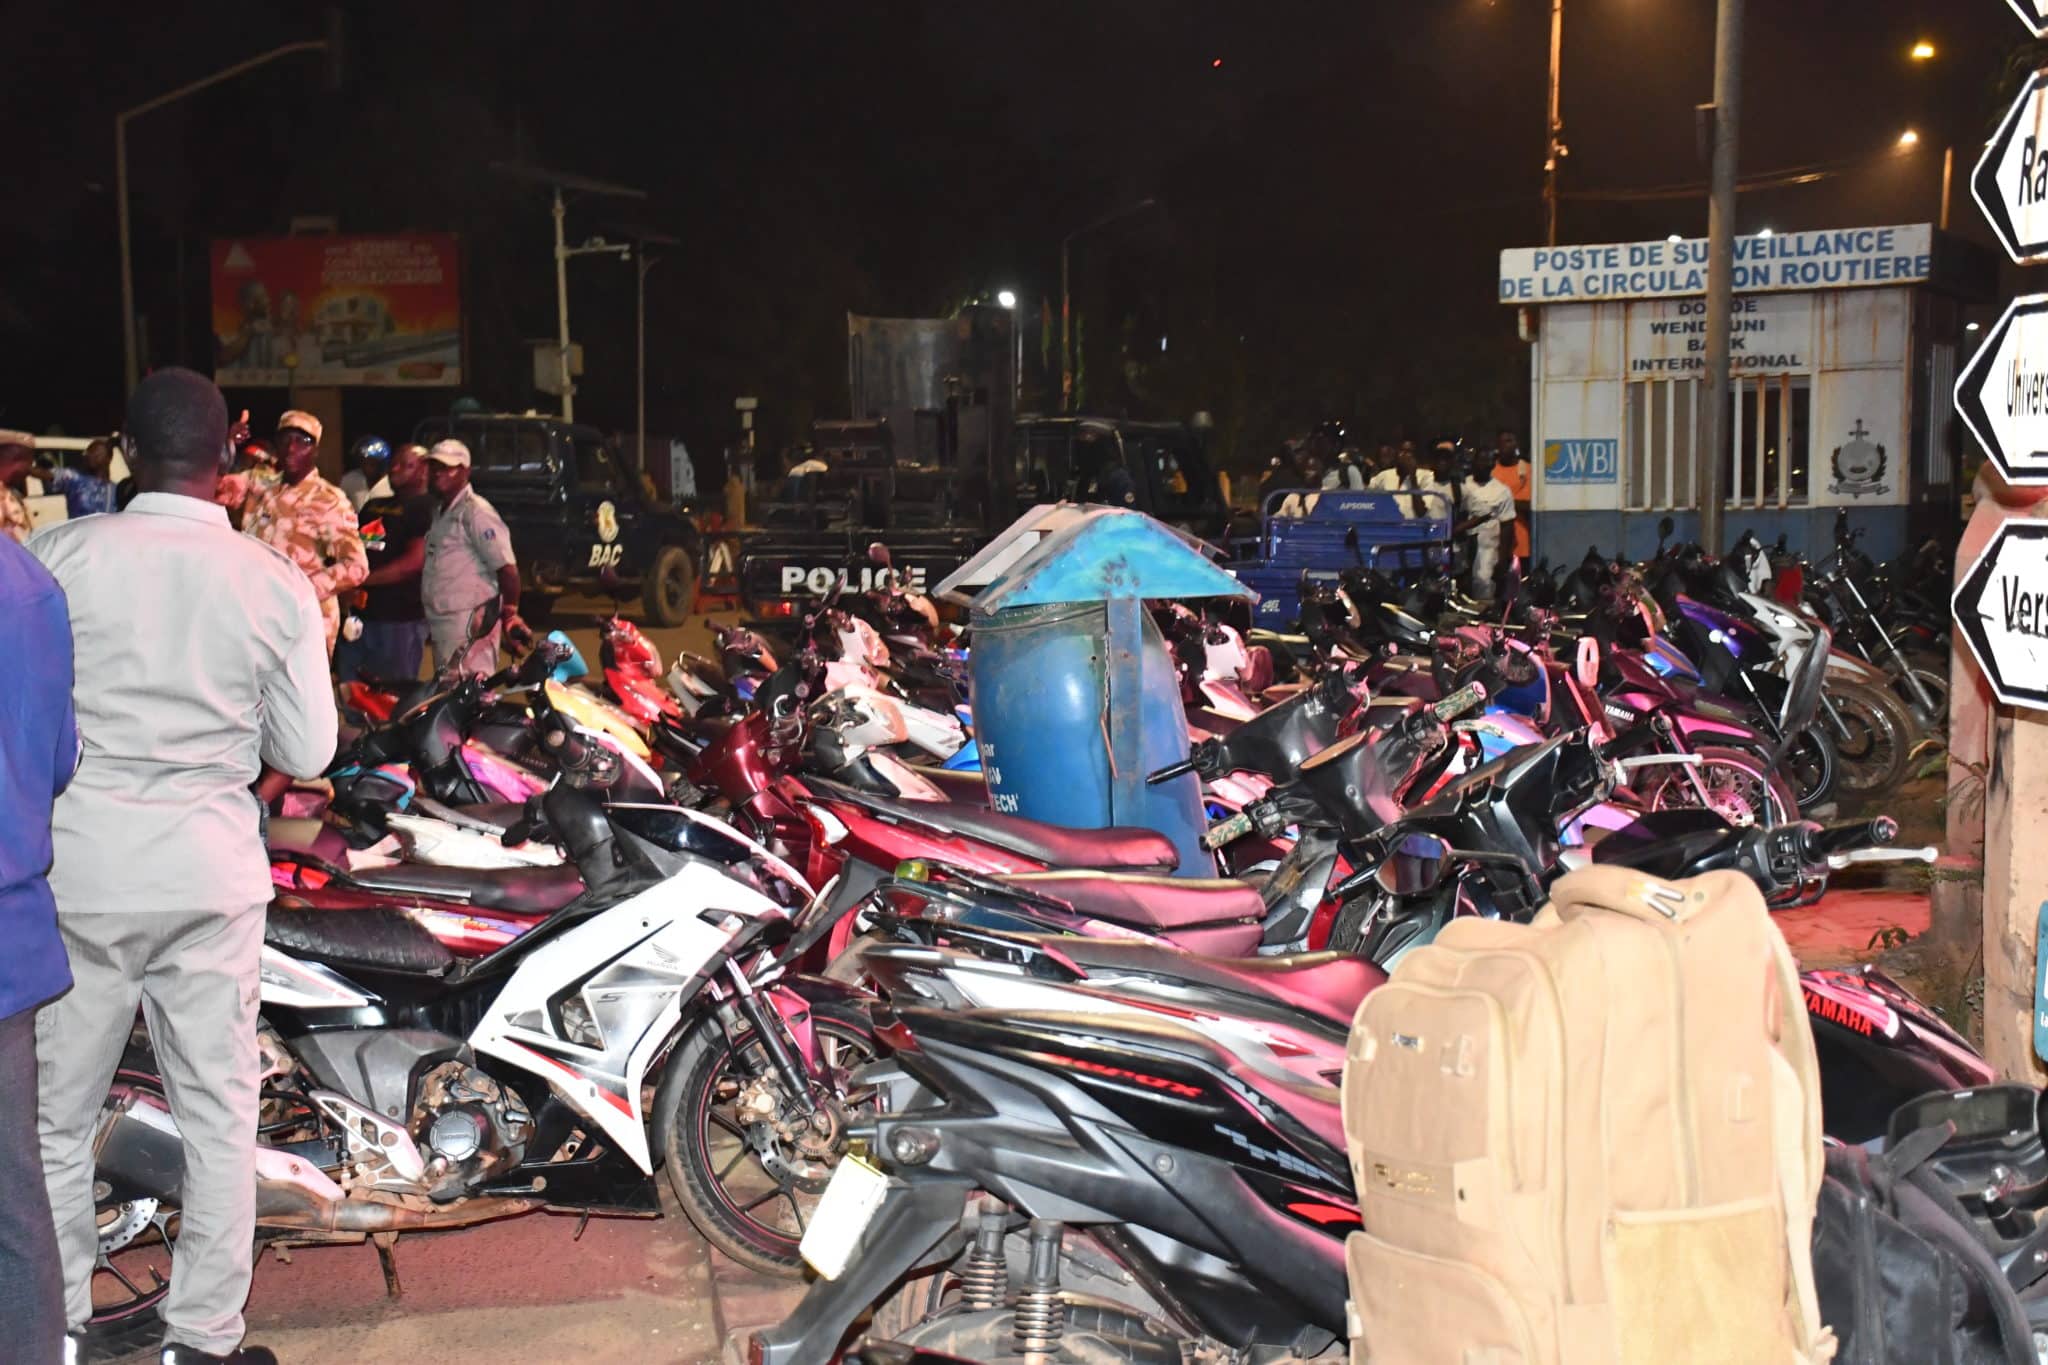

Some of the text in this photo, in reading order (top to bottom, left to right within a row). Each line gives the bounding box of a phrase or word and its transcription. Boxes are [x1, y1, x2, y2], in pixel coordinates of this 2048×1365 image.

[1534, 229, 1895, 272] POSTE DE SUVEILLANCE
[1501, 254, 1931, 299] DE LA CIRCULAON ROUTIERE
[1566, 441, 1617, 474] WBI
[588, 543, 624, 568] BAC
[781, 566, 927, 595] POLICE
[1605, 703, 1635, 722] YAMAHA
